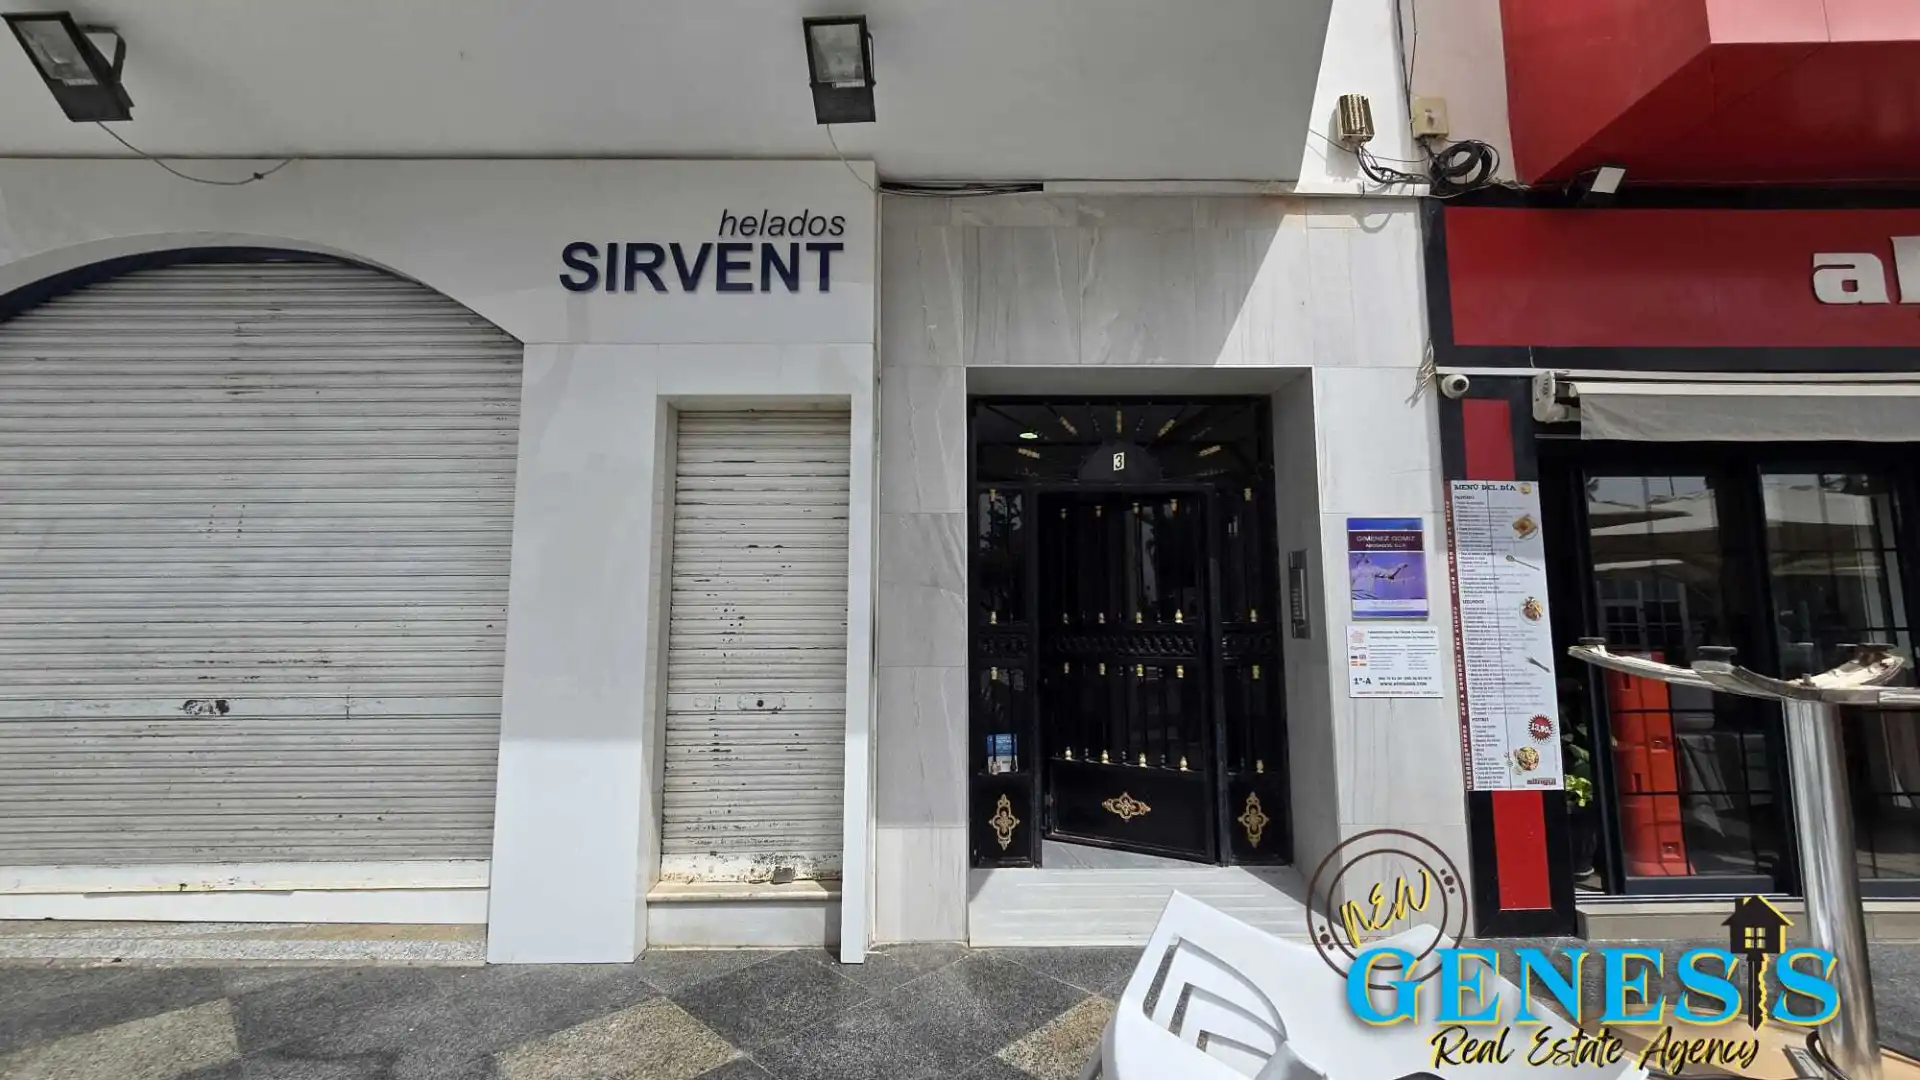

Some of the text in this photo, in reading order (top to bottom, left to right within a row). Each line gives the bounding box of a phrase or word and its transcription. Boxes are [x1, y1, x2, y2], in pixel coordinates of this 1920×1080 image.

[718, 209, 846, 237] helados
[559, 241, 844, 293] SIRVENT
[1115, 454, 1123, 469] 3
